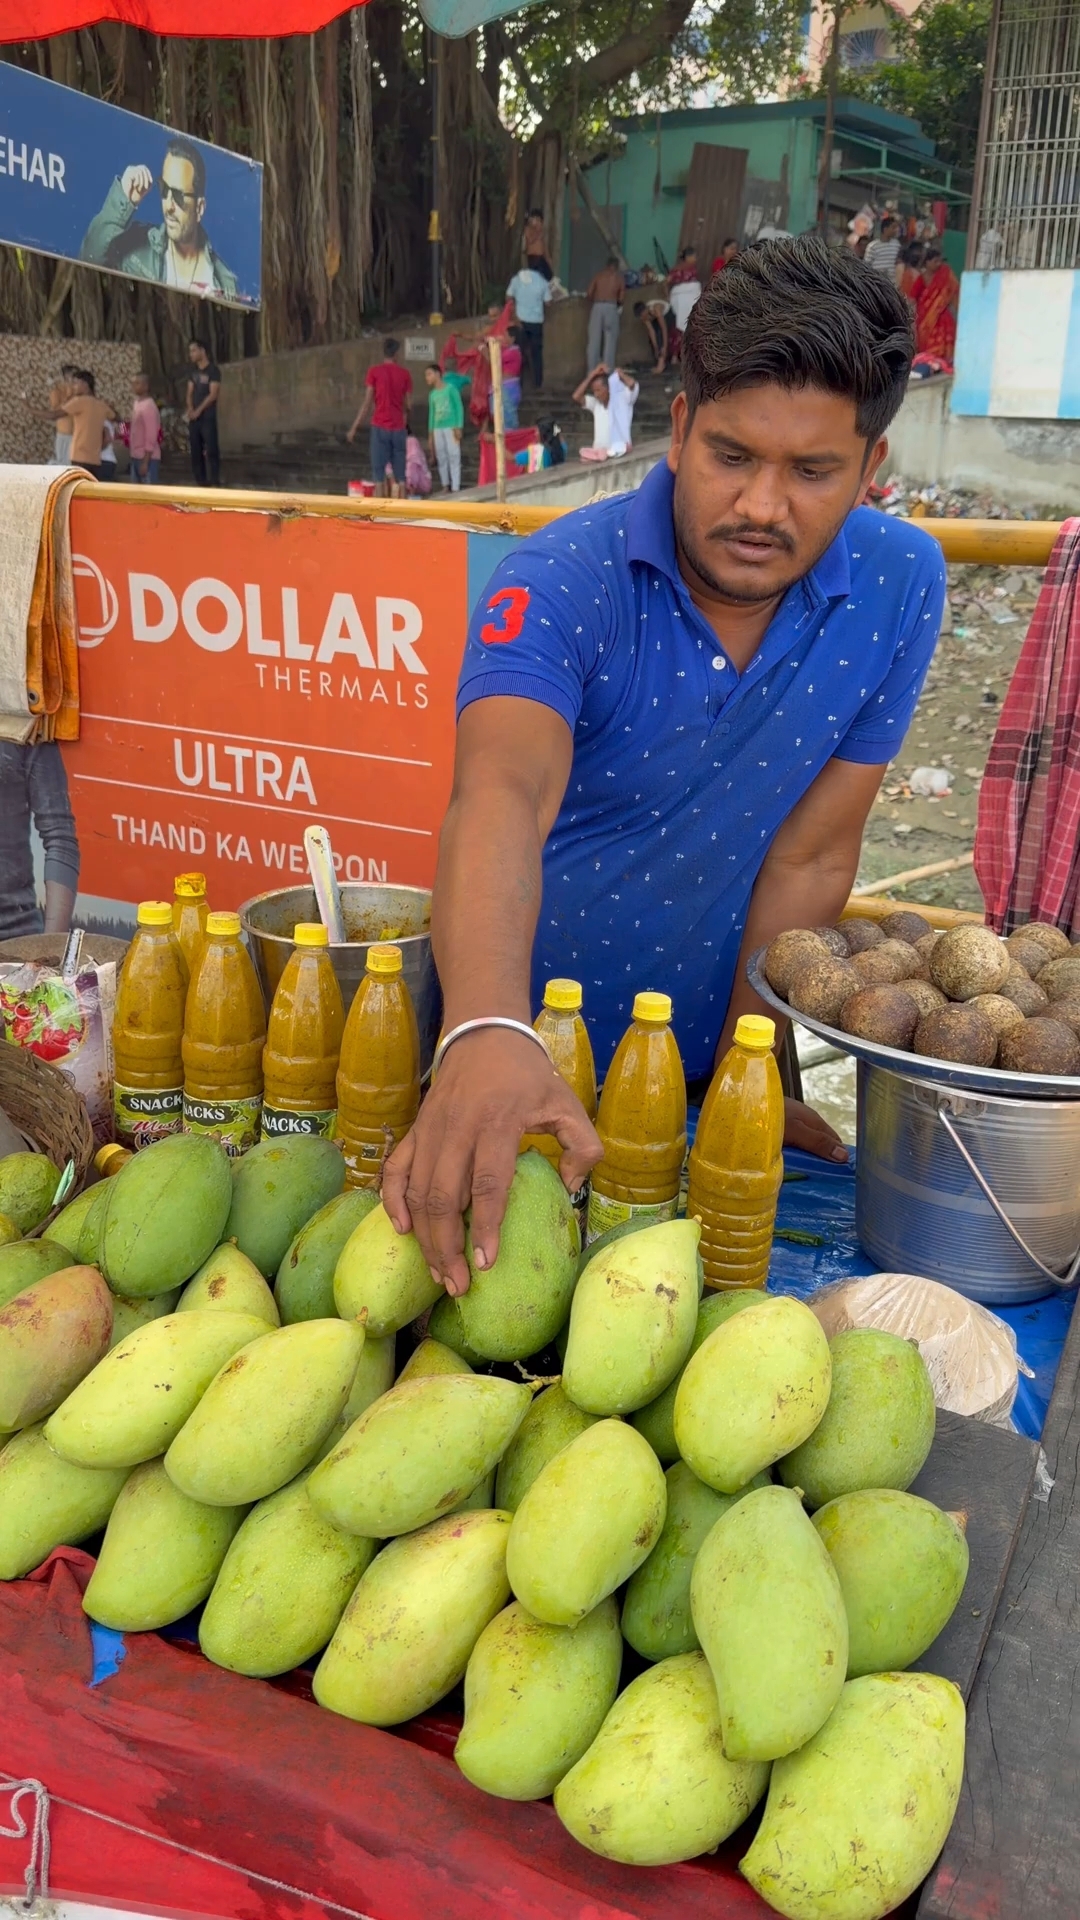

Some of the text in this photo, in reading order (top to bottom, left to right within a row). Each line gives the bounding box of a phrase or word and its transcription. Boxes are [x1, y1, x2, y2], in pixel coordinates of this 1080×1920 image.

[128, 572, 429, 675] DOLLAR
[480, 586, 531, 645] 3
[255, 663, 428, 709] THERMALS
[174, 738, 318, 805] ULTRA
[111, 814, 387, 883] THAND KA WEPON
